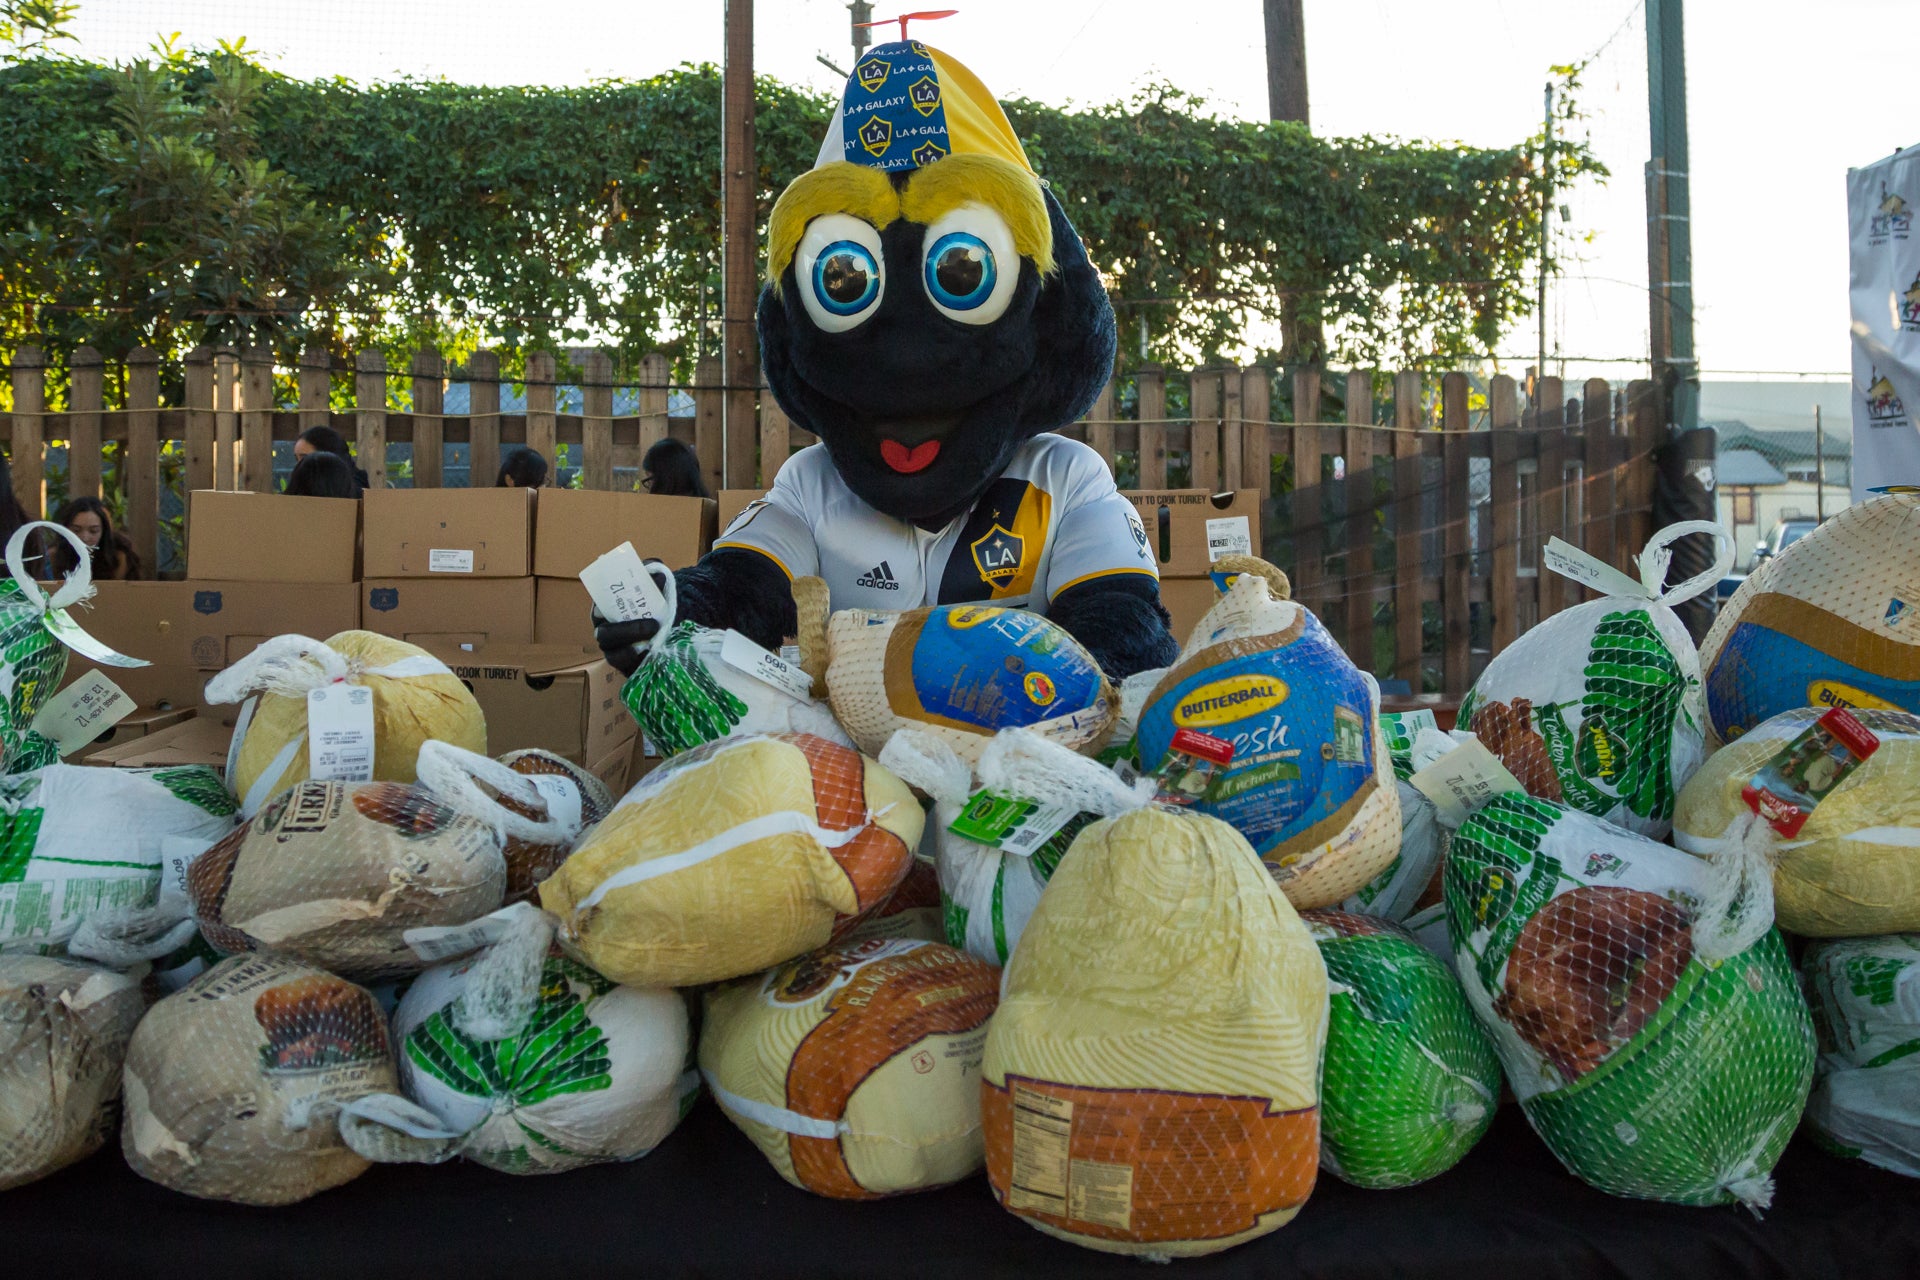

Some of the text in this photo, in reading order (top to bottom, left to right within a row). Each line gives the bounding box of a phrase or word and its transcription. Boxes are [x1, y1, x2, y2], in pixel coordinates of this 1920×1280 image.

[864, 69, 882, 79] LA
[917, 90, 935, 101] LA
[865, 95, 906, 111] GALAXY
[867, 130, 886, 143] LA
[896, 129, 909, 138] LA
[1146, 495, 1155, 504] TO
[1156, 495, 1176, 505] COOK
[1178, 495, 1206, 504] TURKEY
[985, 548, 1016, 567] LA
[856, 577, 899, 590] adidas
[456, 667, 518, 680] COOK TURKEY
[1181, 686, 1277, 719] BUTTERBALL
[1543, 712, 1569, 764] Tender
[1557, 766, 1574, 778] &
[1236, 762, 1287, 791] natural
[1522, 873, 1557, 914] Juicy
[848, 961, 907, 1007] RANCH
